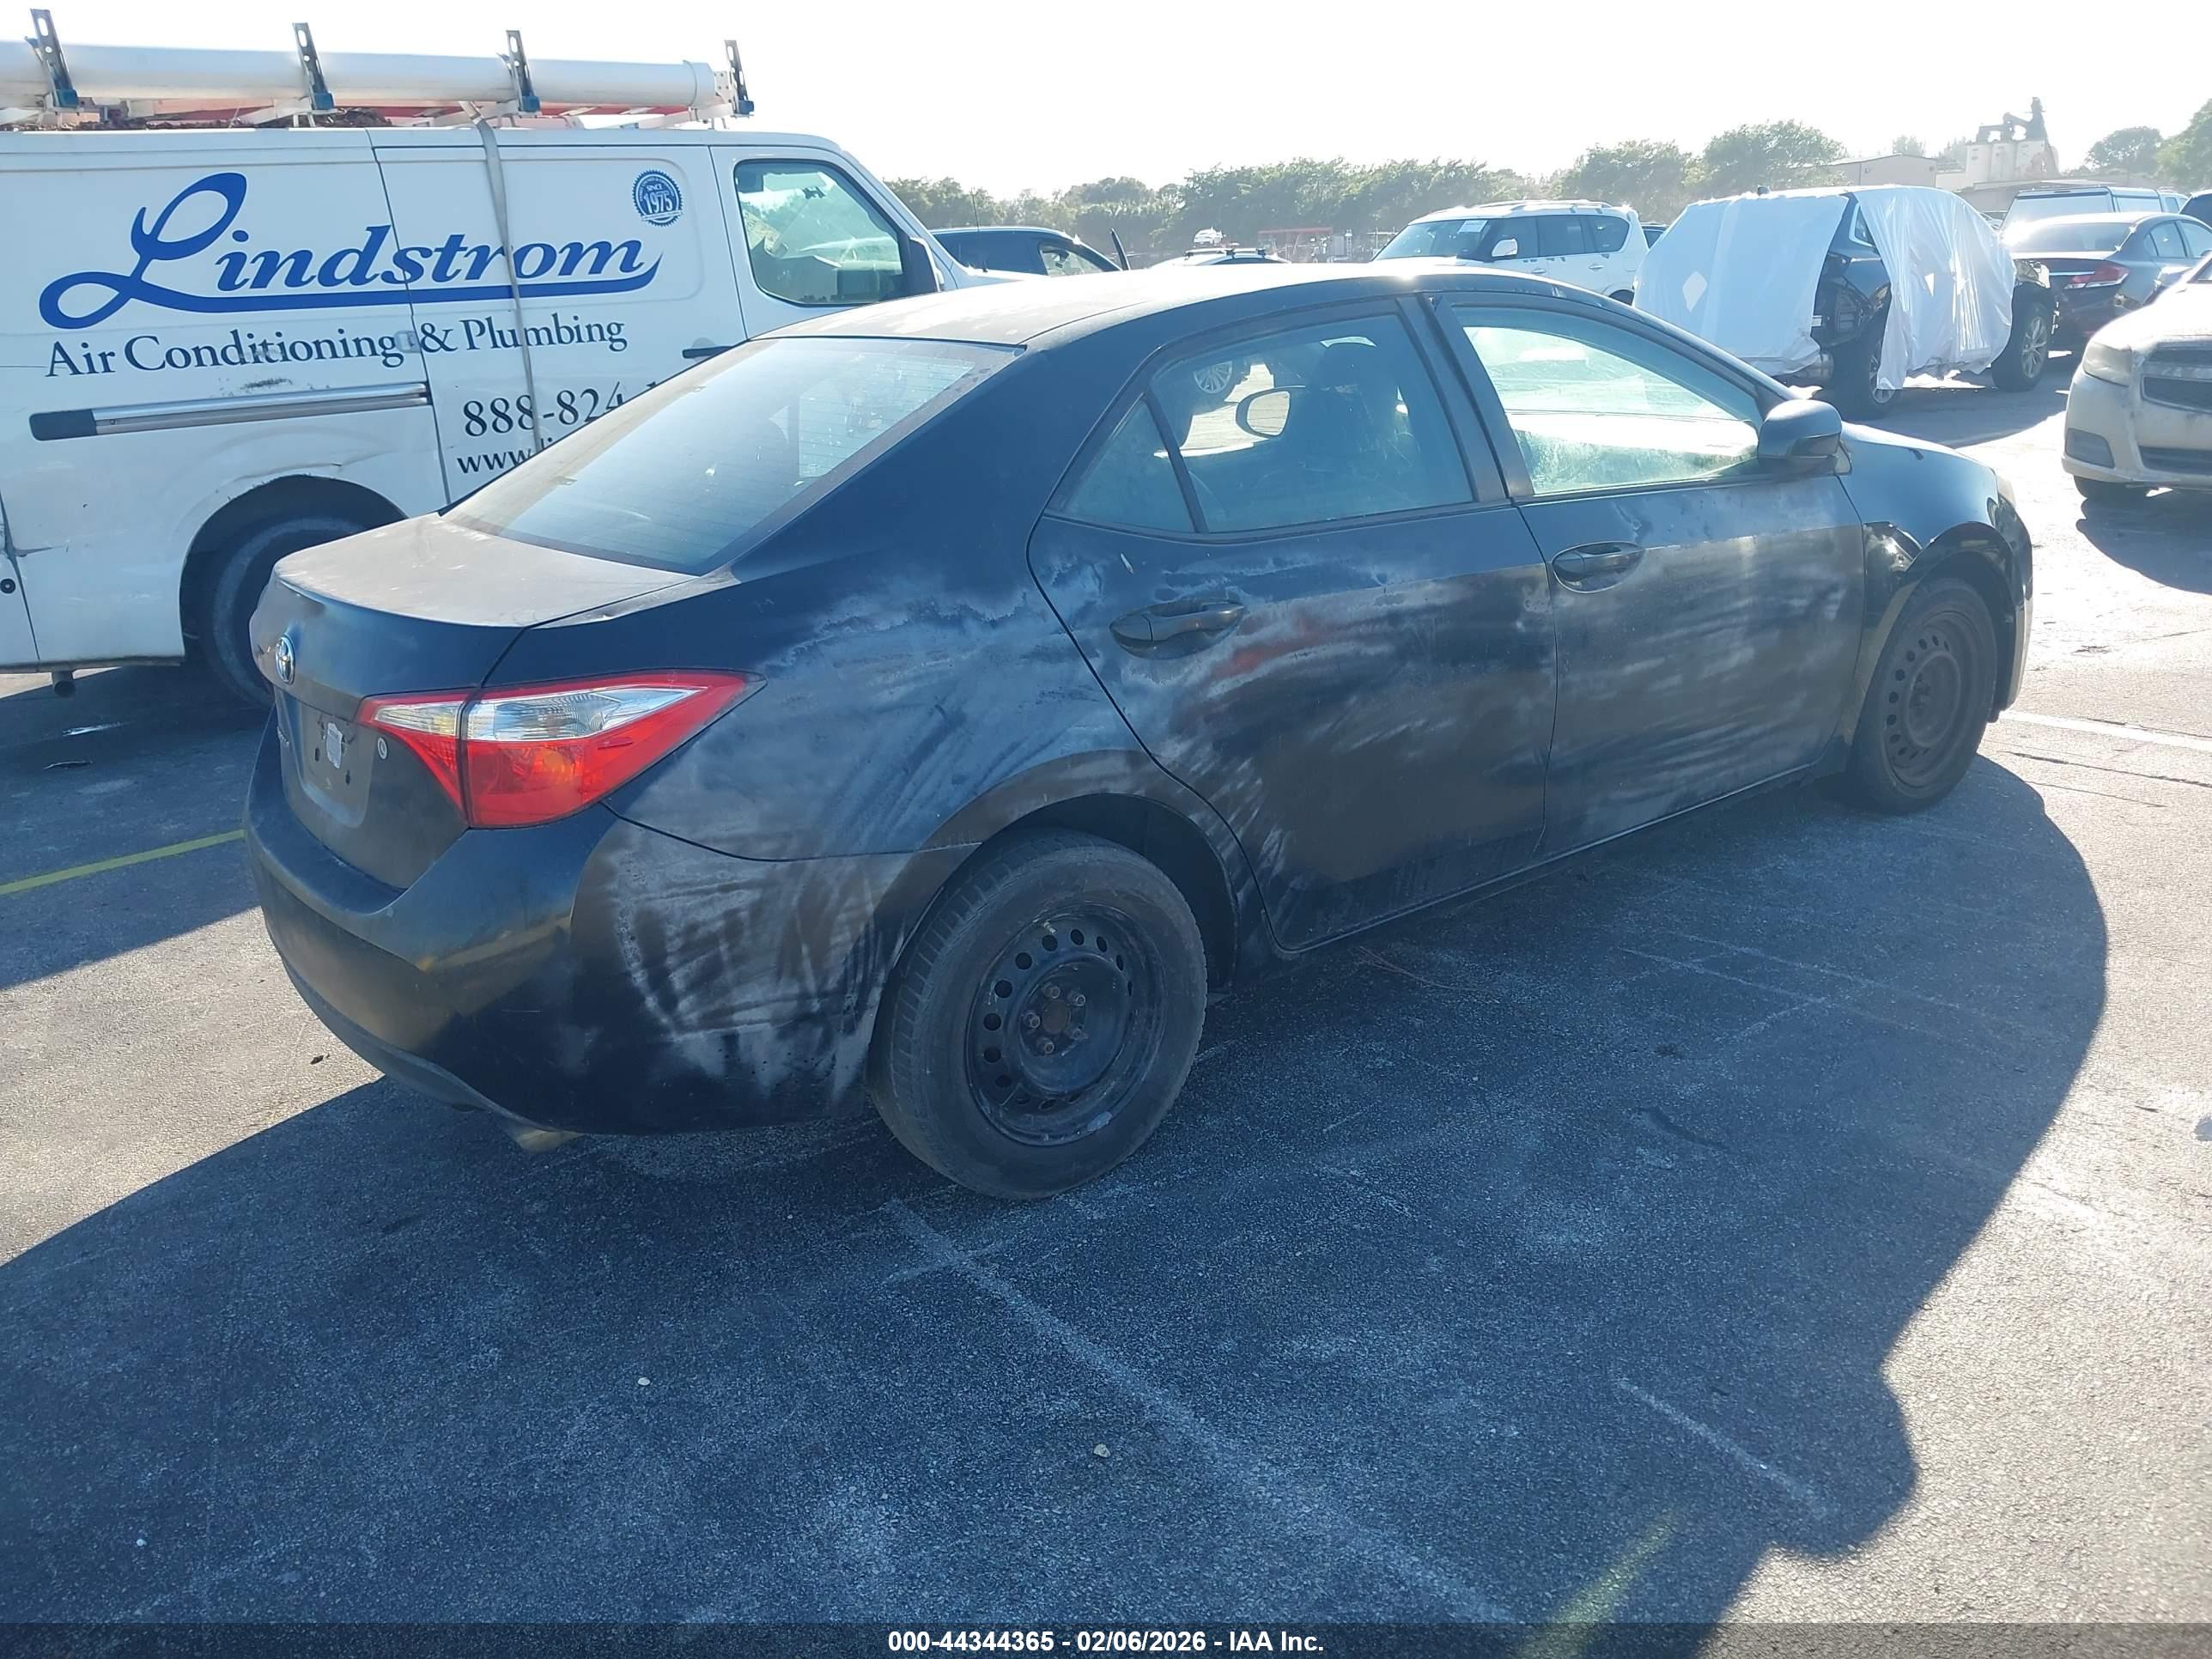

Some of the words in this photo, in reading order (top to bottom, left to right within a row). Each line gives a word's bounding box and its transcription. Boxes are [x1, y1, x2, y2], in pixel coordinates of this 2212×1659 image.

[643, 191, 673, 213] 1975
[40, 173, 662, 329] Lindstrom
[46, 341, 116, 376] Air
[125, 329, 404, 368] Conditioning
[421, 322, 458, 353] &
[460, 313, 628, 353] Plumbing
[463, 380, 656, 436] 888-824
